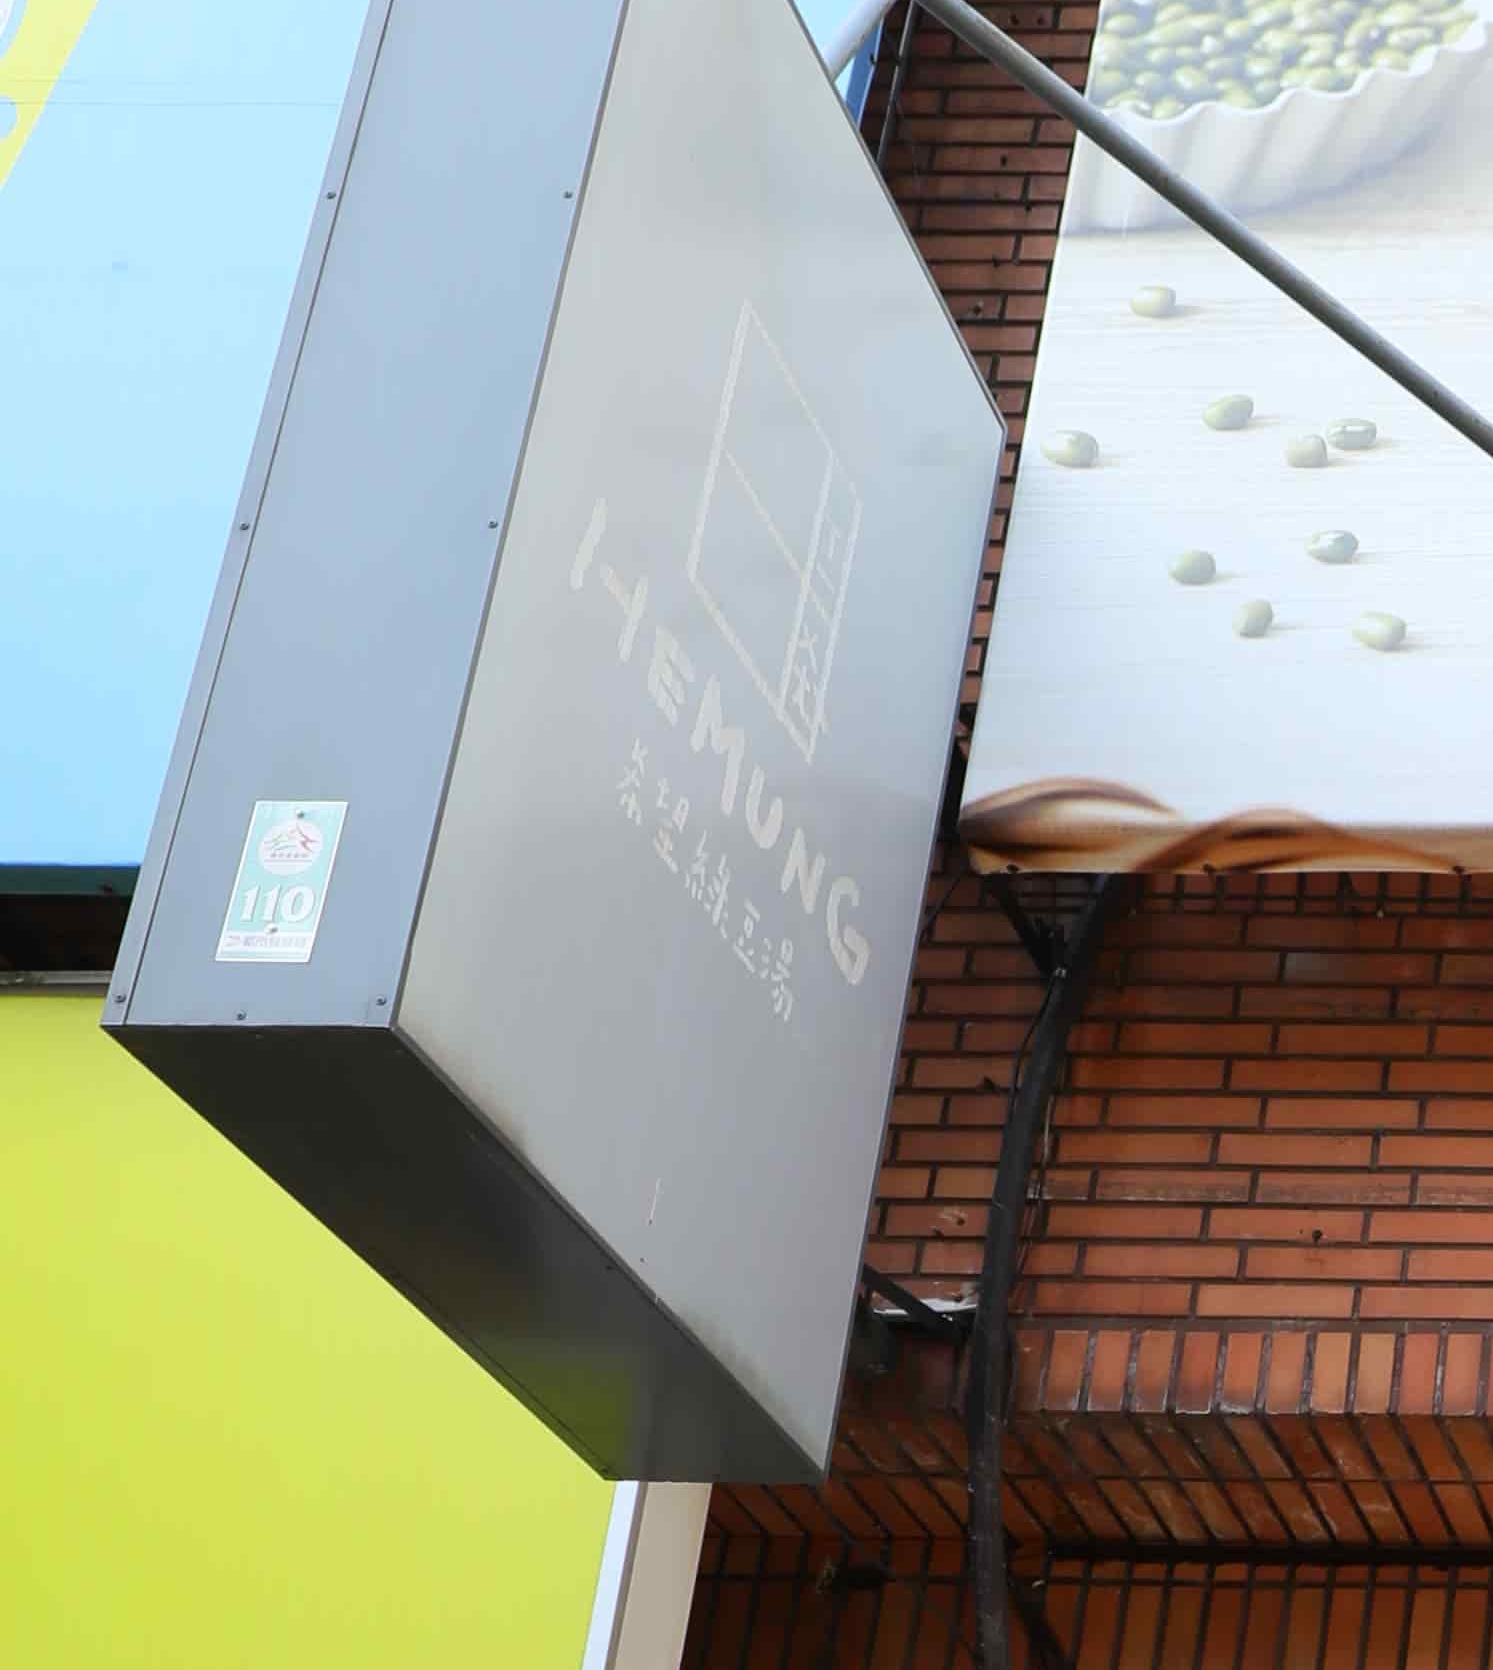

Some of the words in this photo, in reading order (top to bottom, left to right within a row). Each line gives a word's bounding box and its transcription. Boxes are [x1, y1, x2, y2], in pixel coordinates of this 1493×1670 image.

[571, 498, 870, 986] HEMUNG
[616, 738, 794, 1023] 希望綠豆湯
[241, 883, 315, 923] 110
